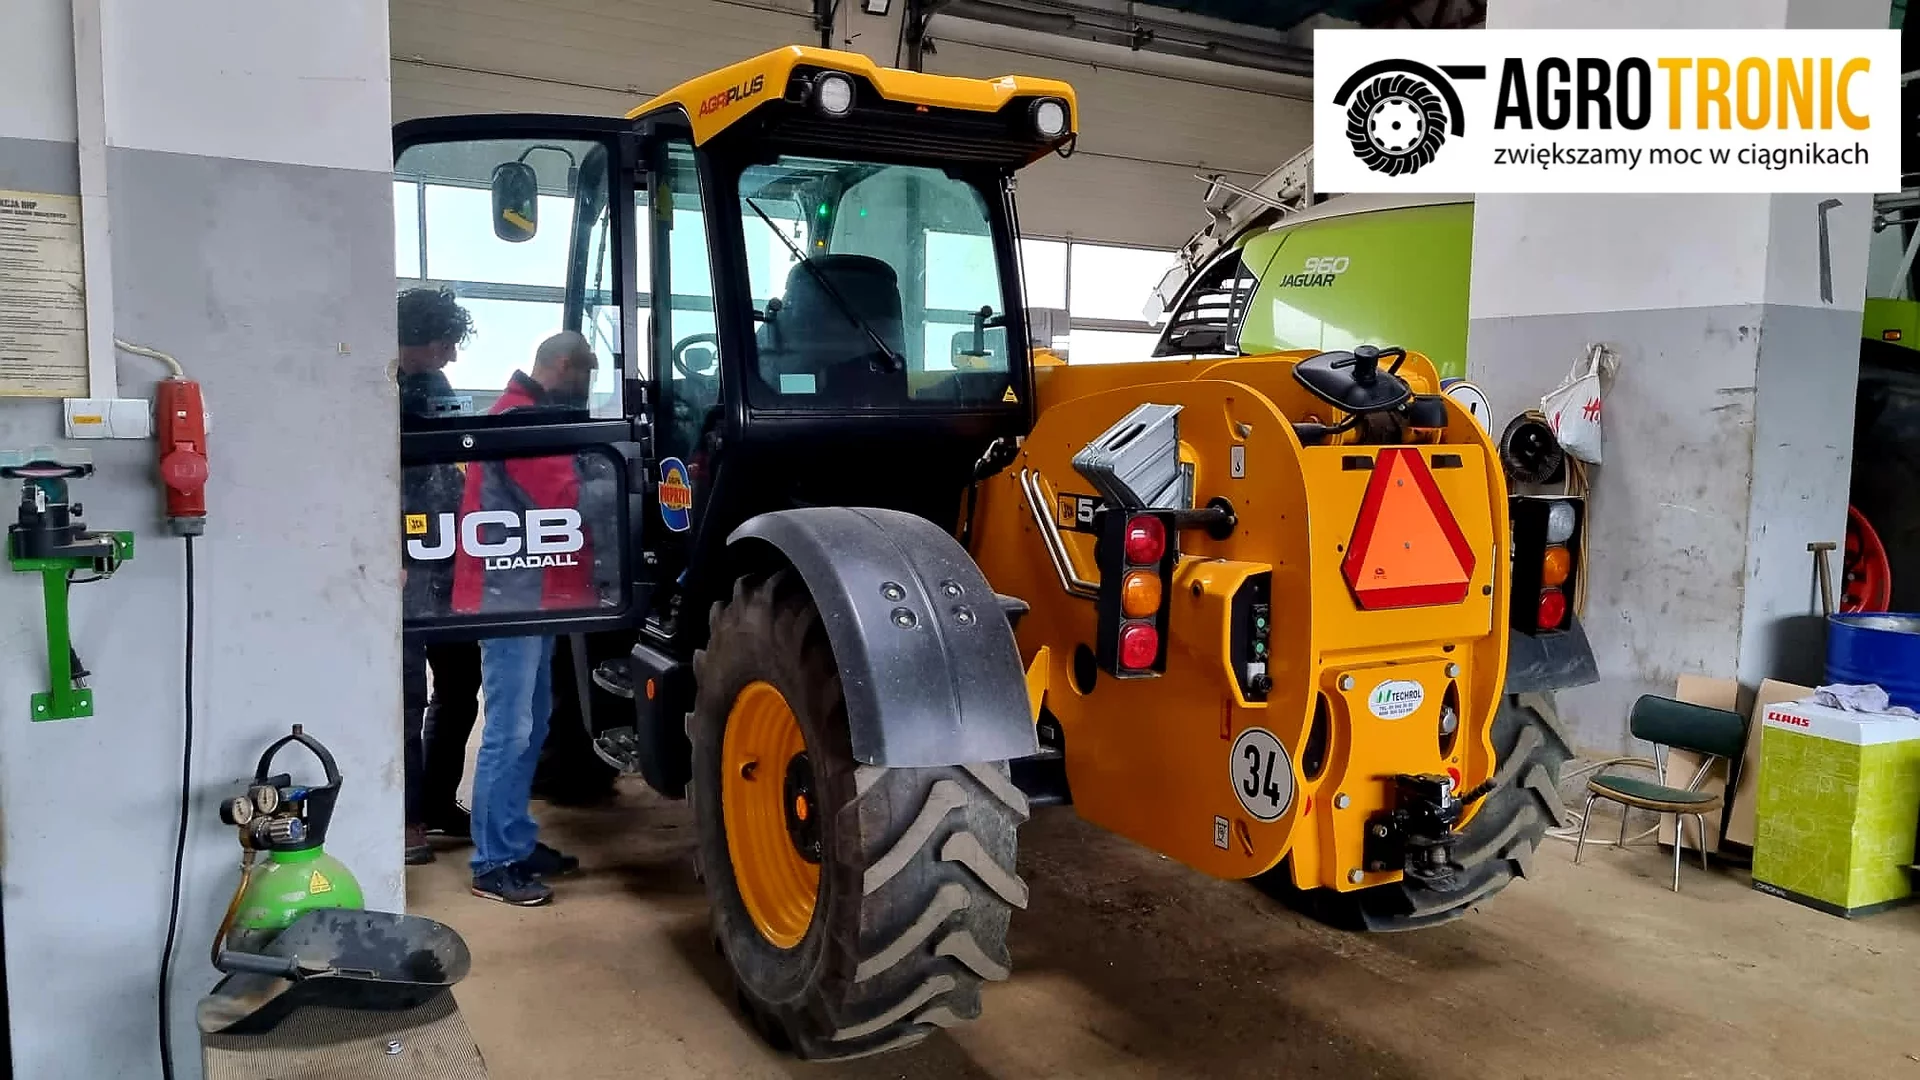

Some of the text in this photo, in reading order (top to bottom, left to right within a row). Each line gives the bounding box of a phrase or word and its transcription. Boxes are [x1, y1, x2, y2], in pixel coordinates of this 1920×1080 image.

[1303, 257, 1349, 274] 960
[1280, 274, 1336, 288] JAGUAR
[407, 508, 584, 560] JCB
[485, 554, 578, 571] LOADALL
[1768, 712, 1810, 728] CLAAS
[1243, 744, 1280, 808] 34
